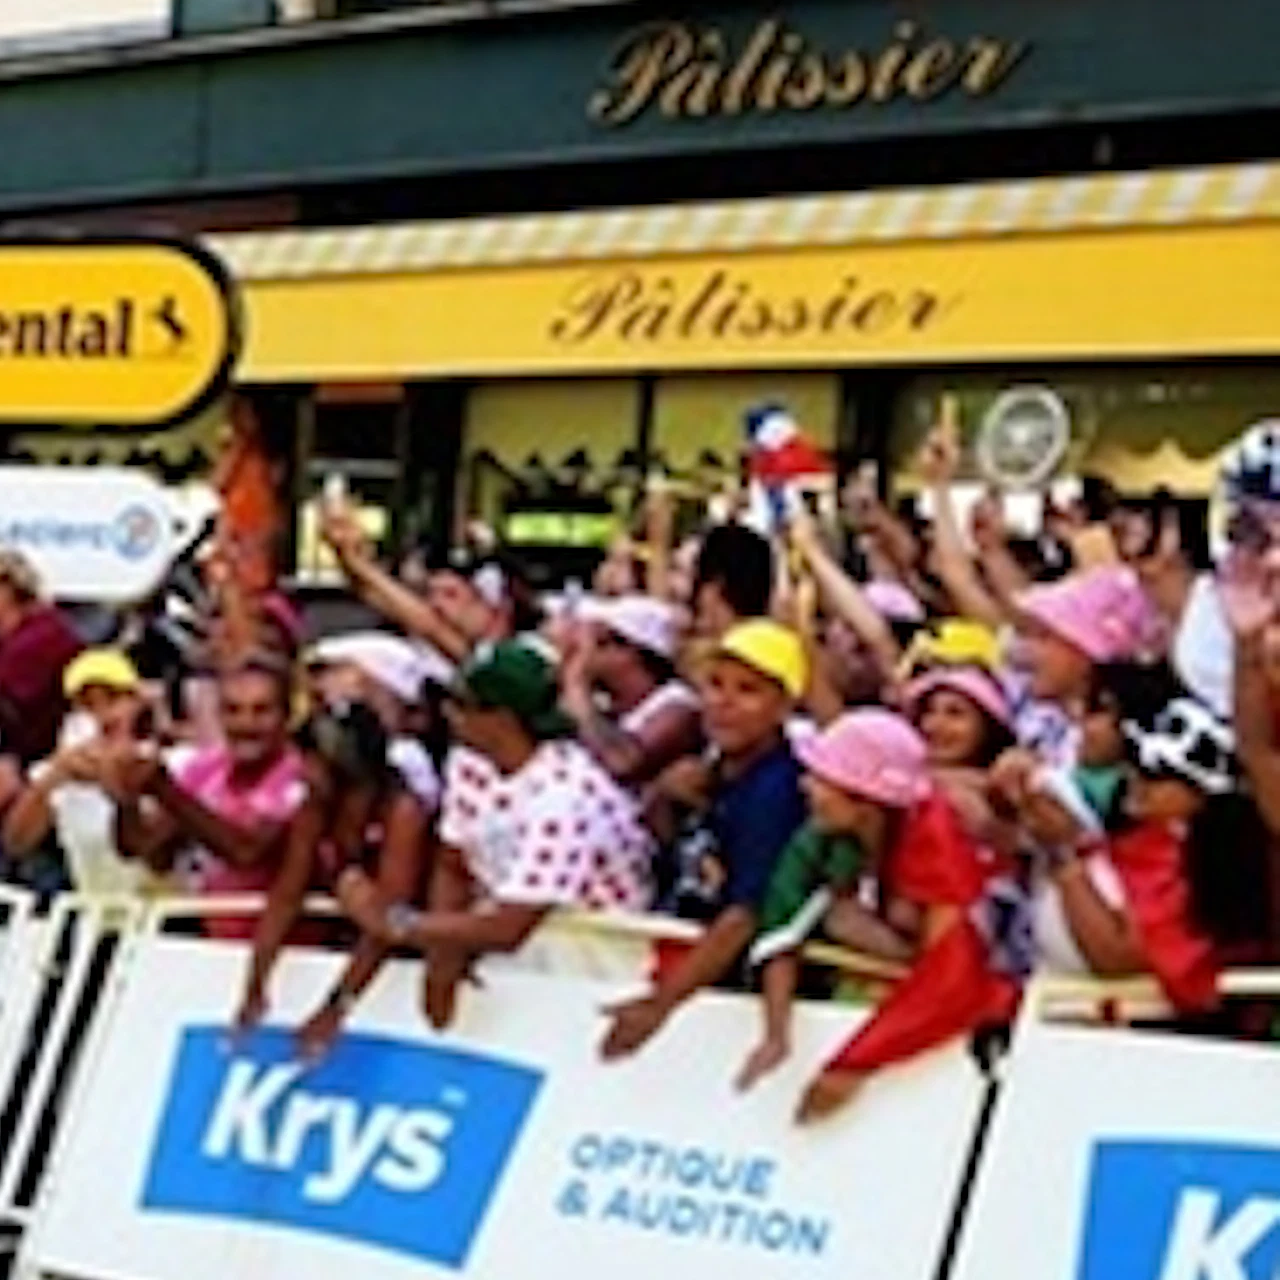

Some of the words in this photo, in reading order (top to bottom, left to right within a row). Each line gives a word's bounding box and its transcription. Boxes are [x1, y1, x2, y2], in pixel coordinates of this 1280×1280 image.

[200, 1057, 455, 1204] Krys
[569, 1132, 777, 1199] OPTIQUE
[600, 1184, 831, 1257] AUDITION
